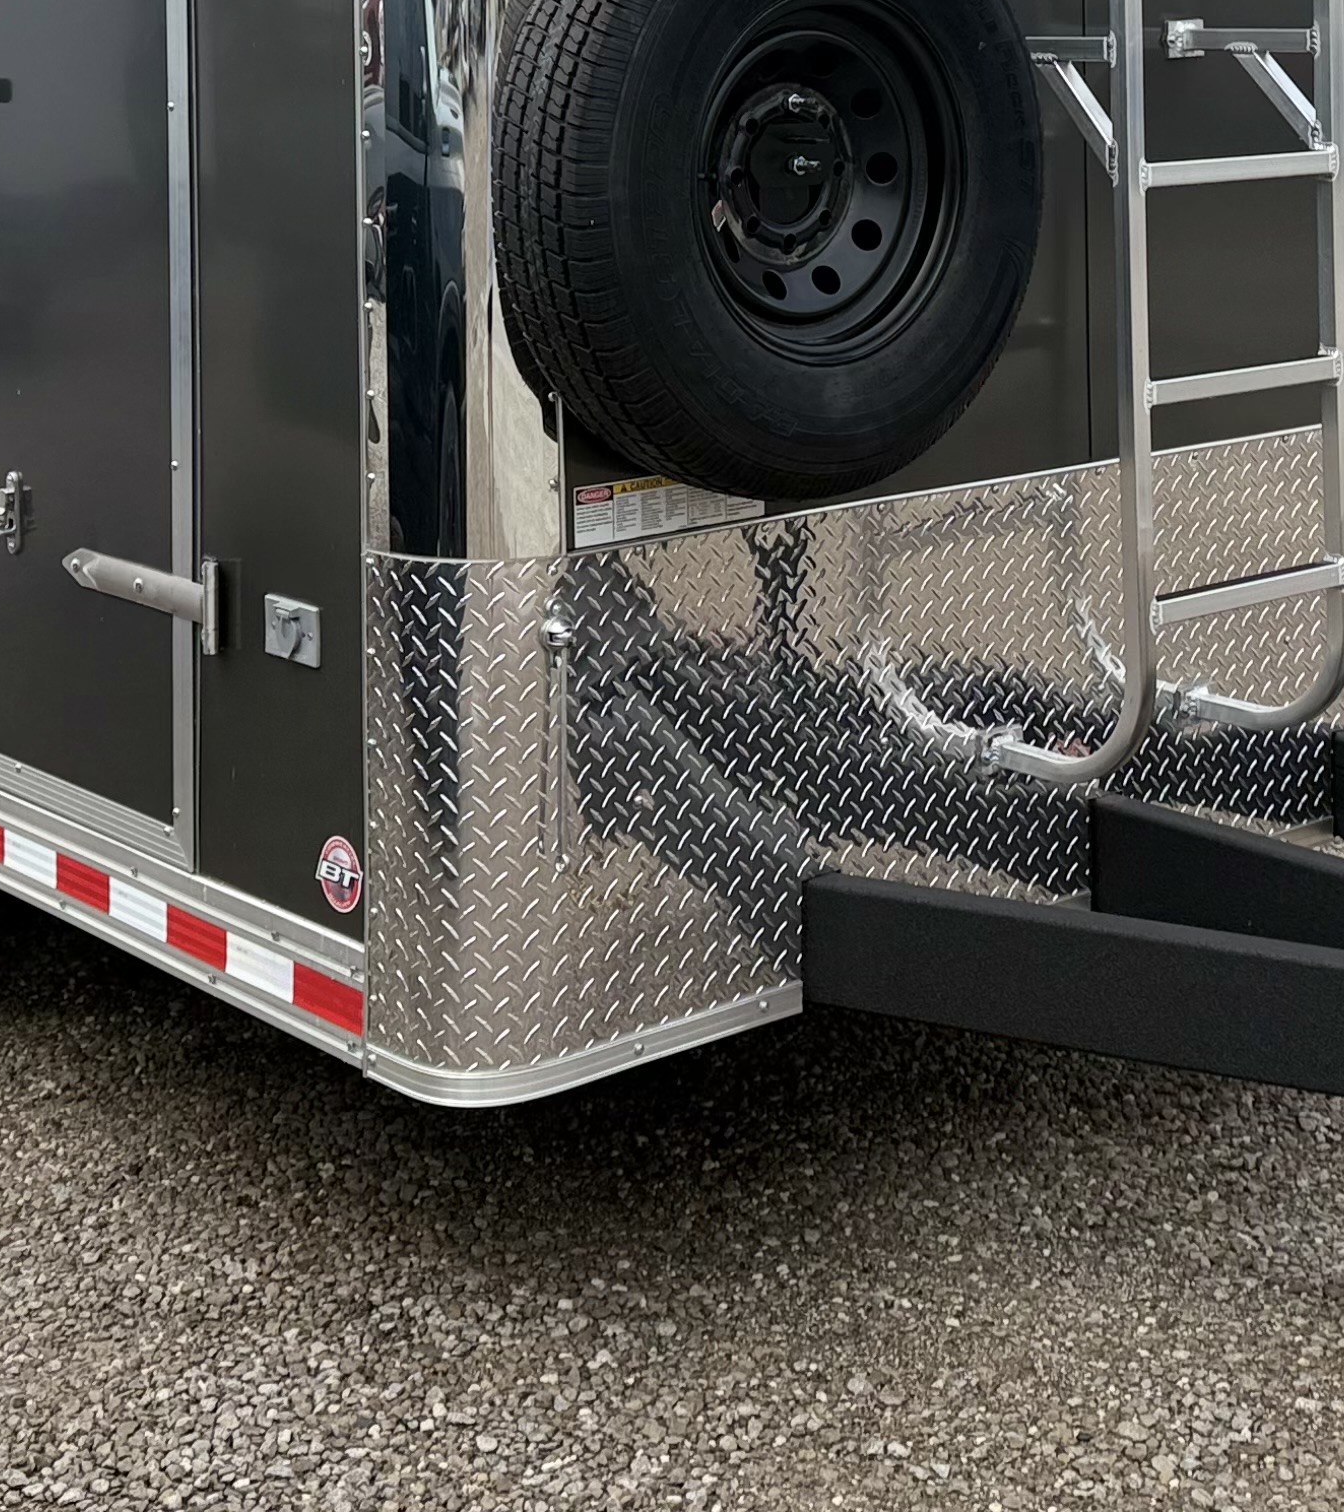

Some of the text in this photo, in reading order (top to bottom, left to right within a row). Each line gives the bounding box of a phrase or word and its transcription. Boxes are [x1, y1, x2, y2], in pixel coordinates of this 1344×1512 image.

[630, 477, 664, 490] CAUTION
[580, 489, 610, 501] DANGER
[319, 860, 360, 888] BT
